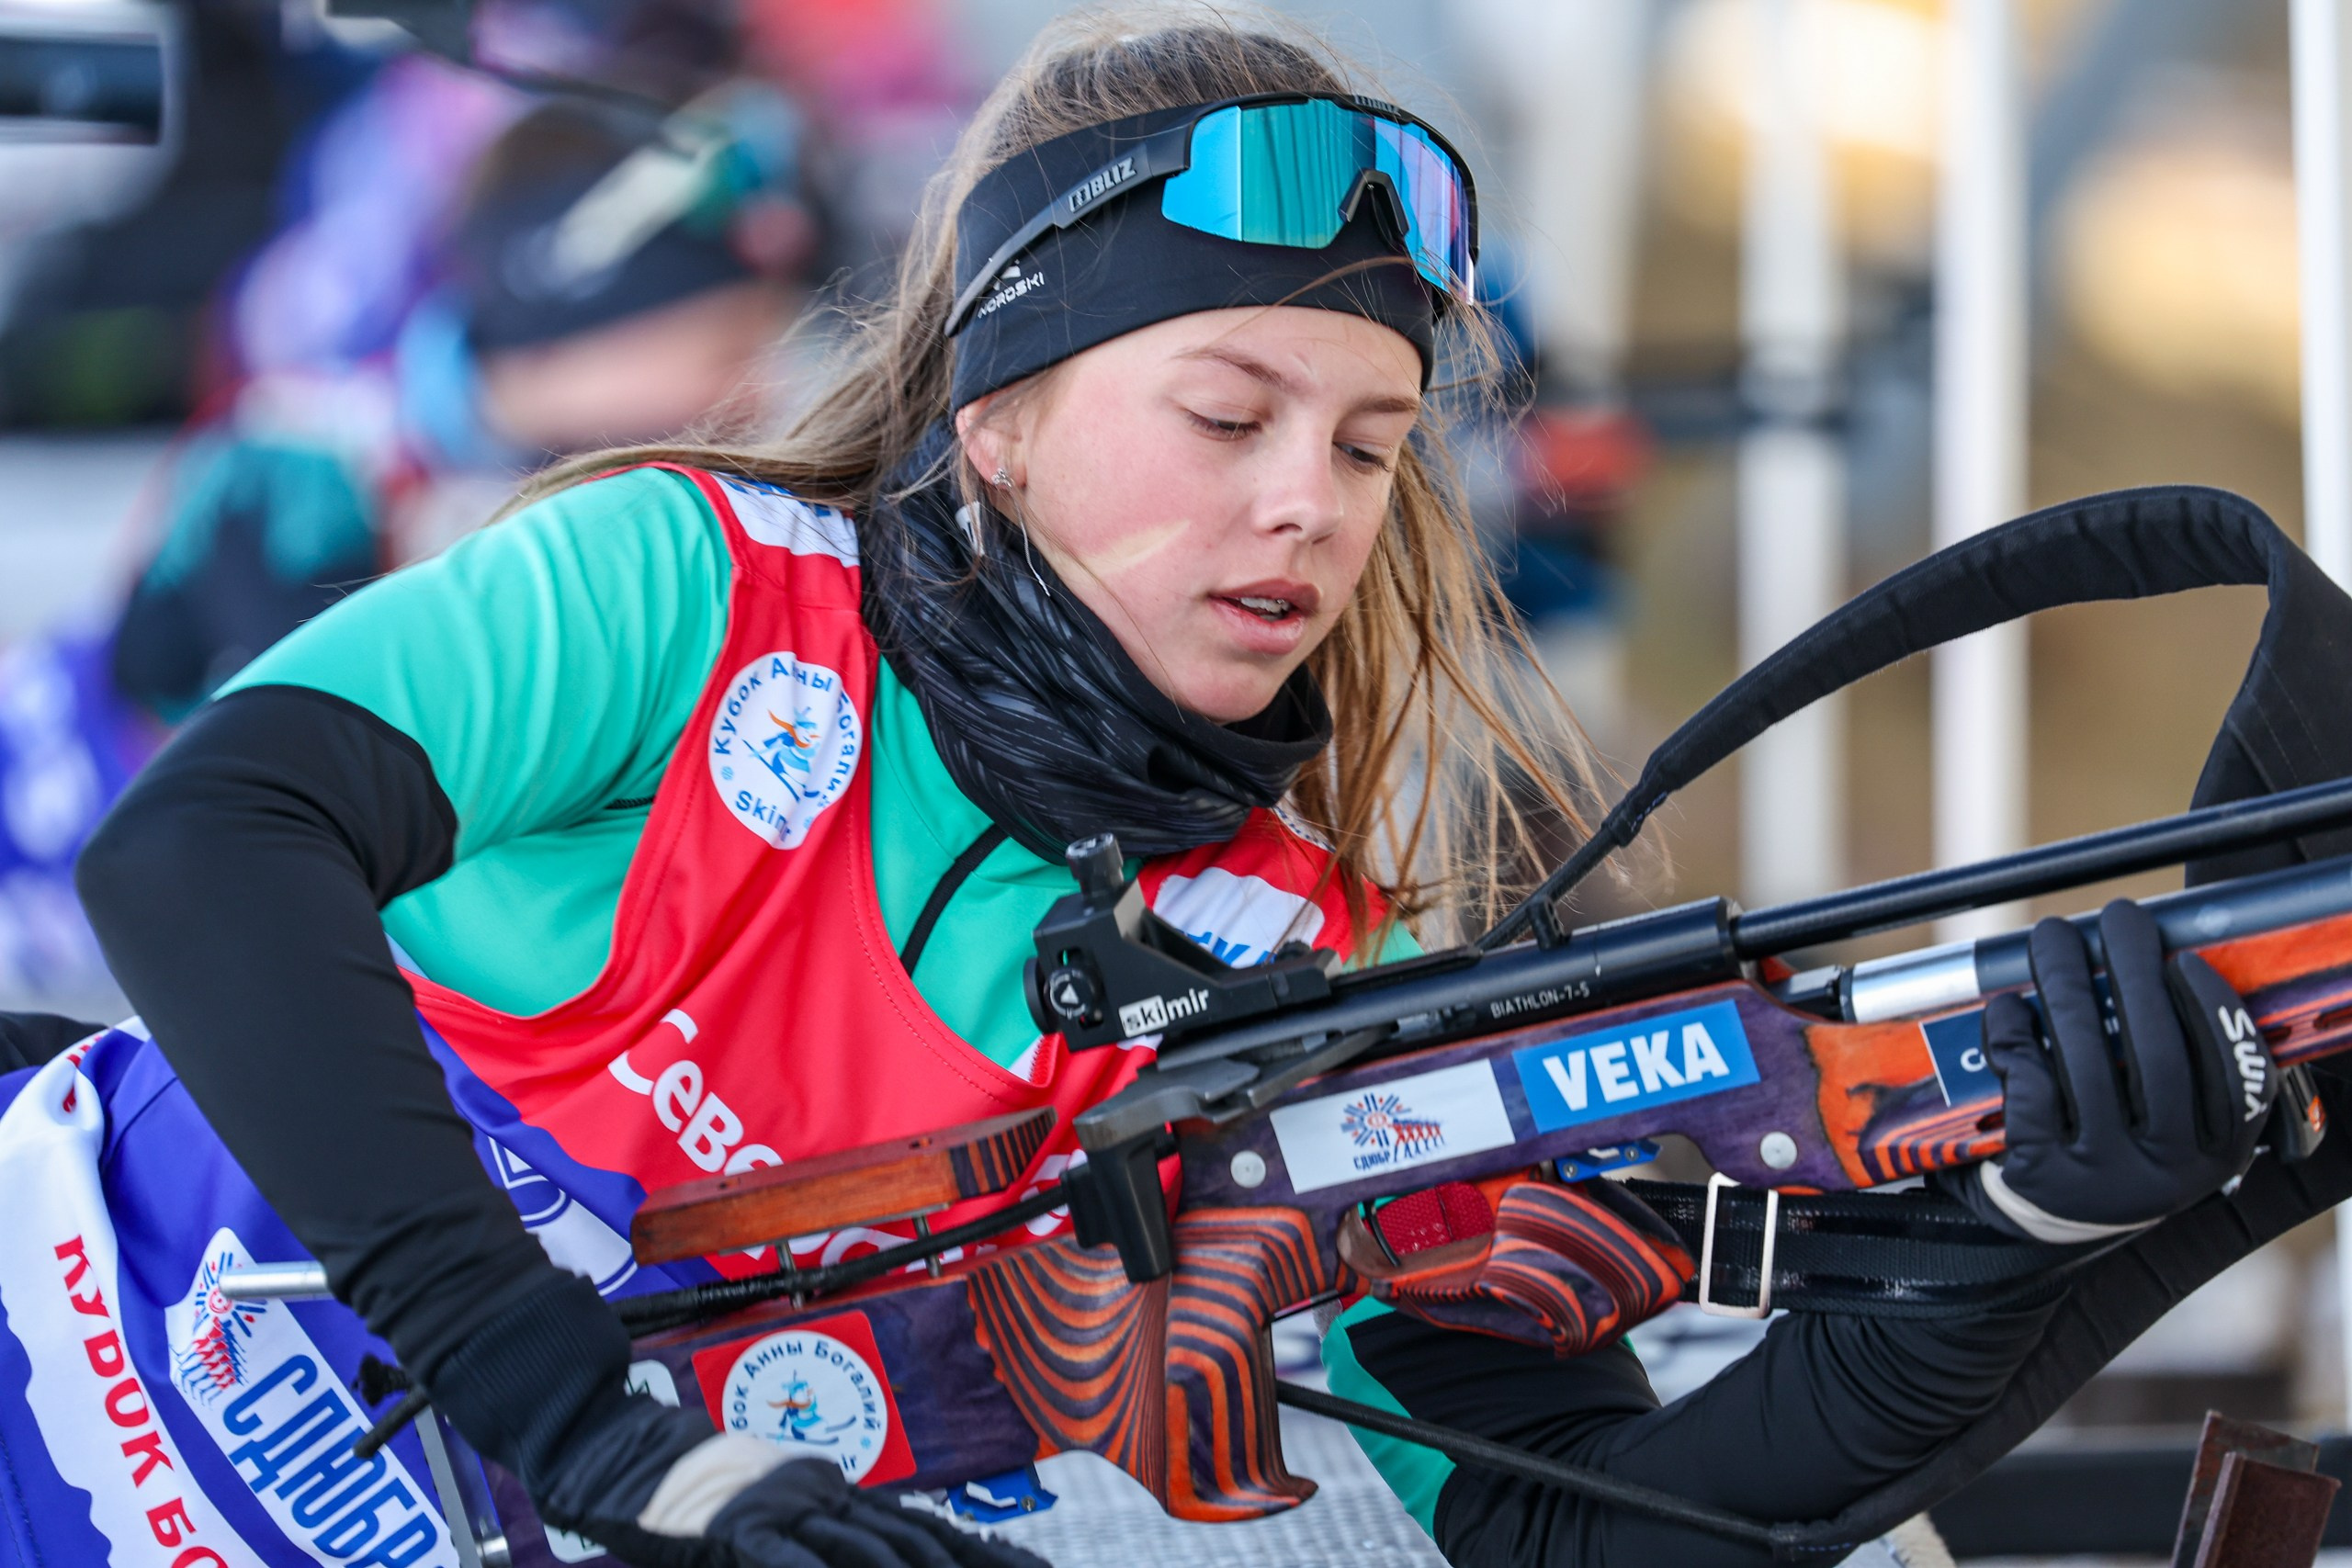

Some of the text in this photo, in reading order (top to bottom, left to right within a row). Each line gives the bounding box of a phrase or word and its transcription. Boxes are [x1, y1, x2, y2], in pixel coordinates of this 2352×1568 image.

[1090, 157, 1136, 198] BLIZ
[1543, 1021, 1730, 1111] VEKA
[743, 1341, 803, 1380] Анны
